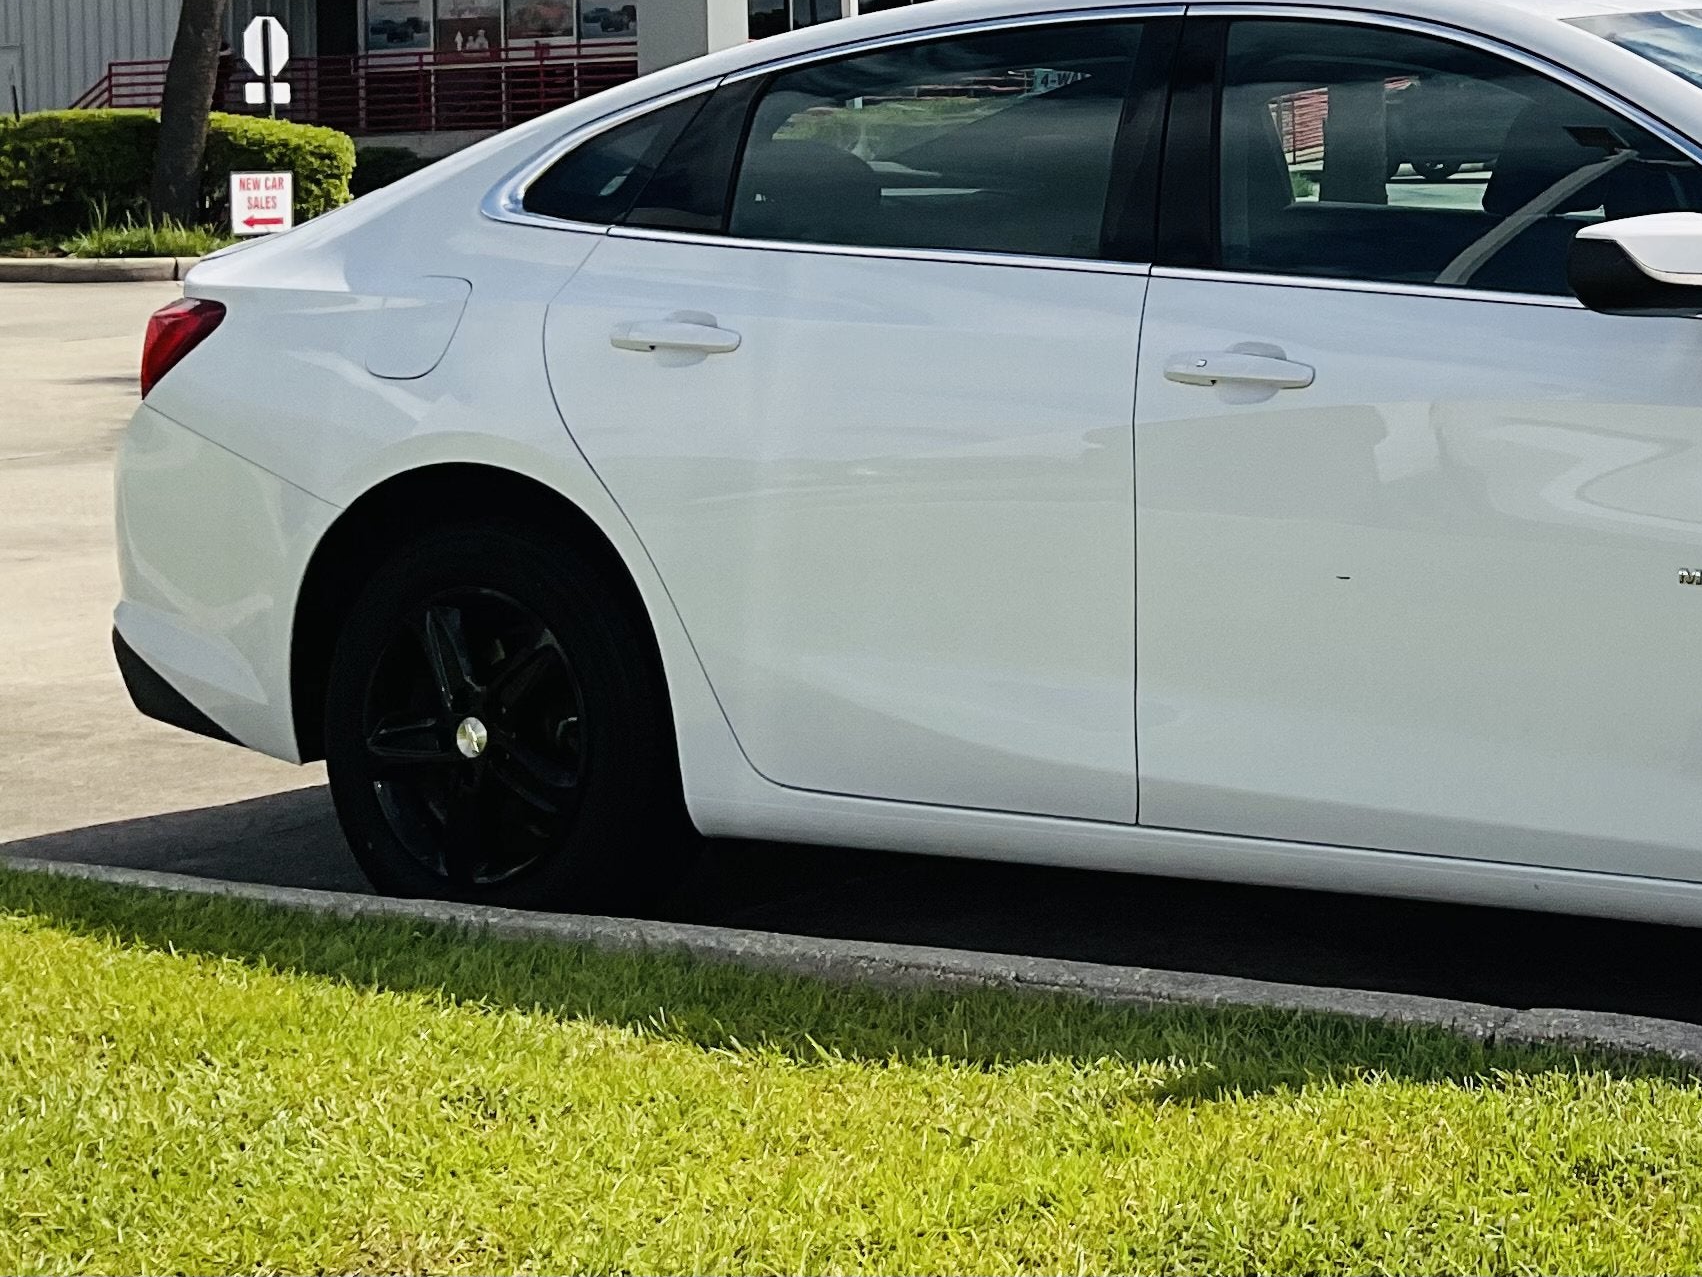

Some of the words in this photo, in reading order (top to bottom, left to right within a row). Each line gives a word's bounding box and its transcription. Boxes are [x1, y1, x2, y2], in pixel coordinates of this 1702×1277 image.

[239, 177, 261, 191] NEW
[264, 176, 285, 190] CAR
[247, 196, 277, 210] SALES
